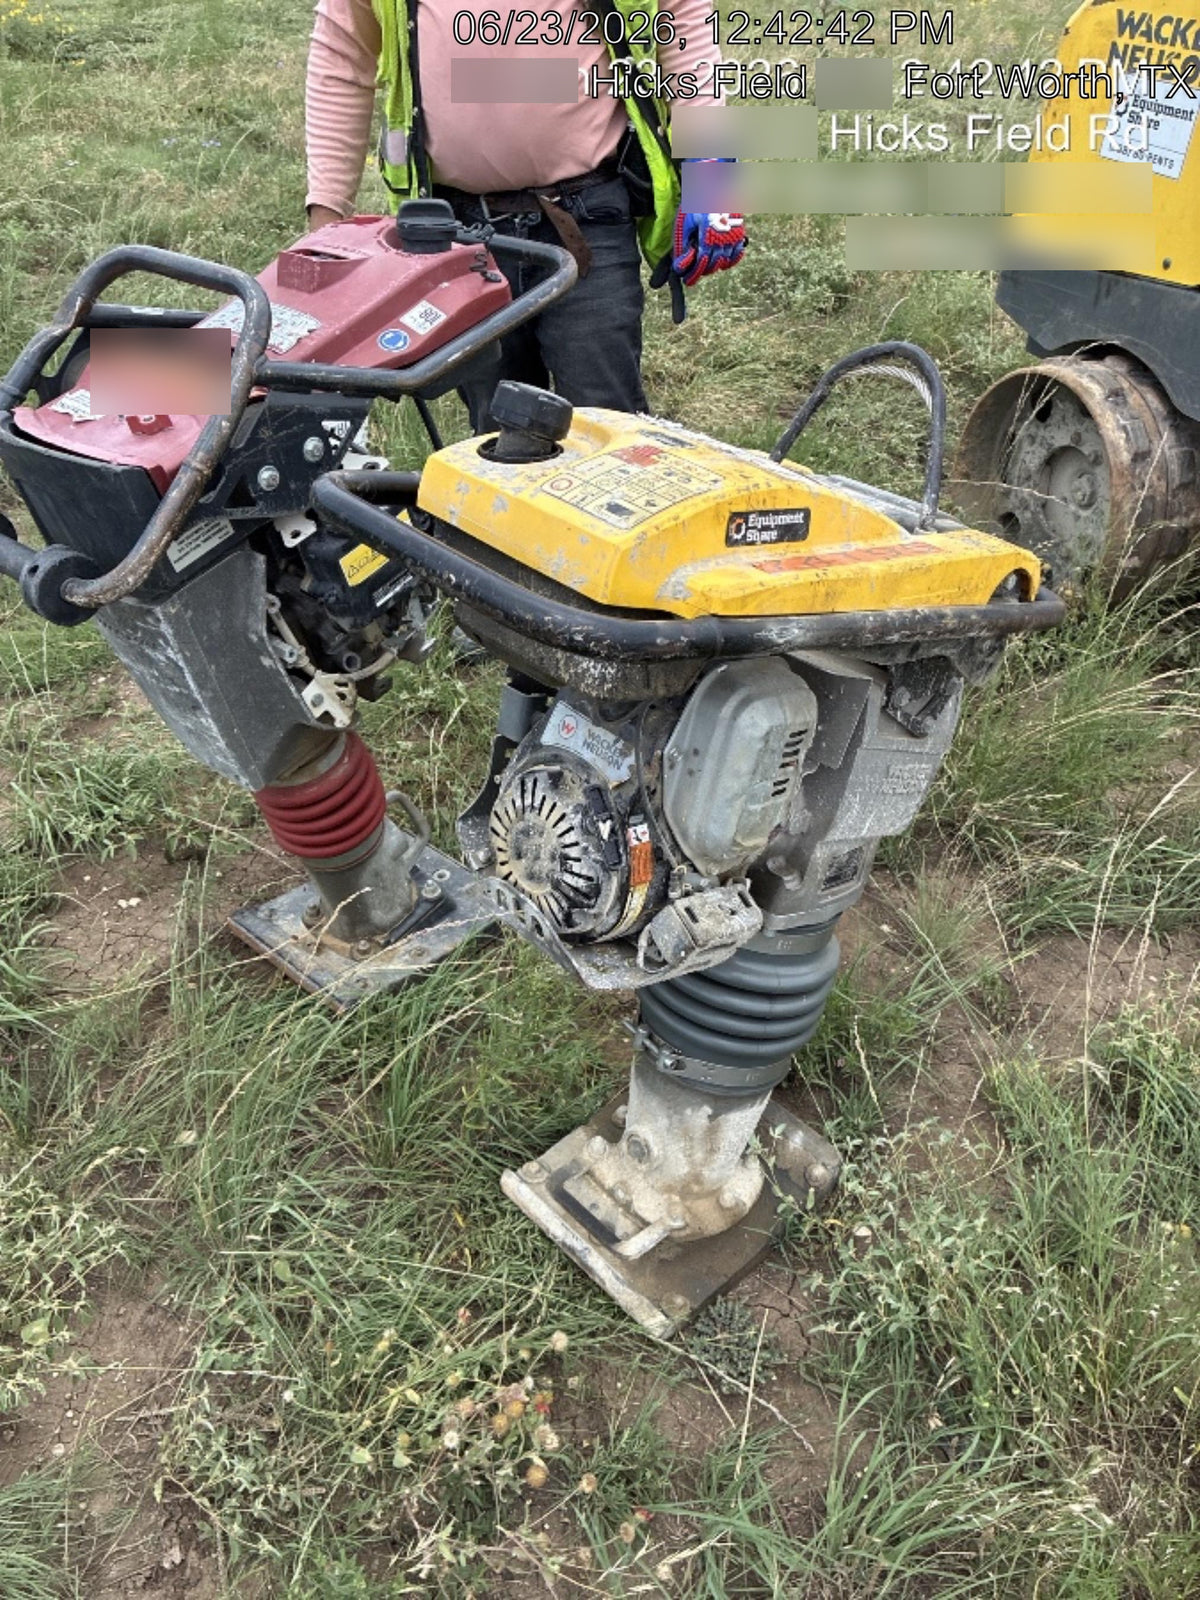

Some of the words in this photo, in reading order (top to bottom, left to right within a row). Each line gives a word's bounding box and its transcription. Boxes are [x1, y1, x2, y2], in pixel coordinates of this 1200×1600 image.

[1131, 94, 1195, 121] Equipment
[1127, 109, 1160, 130] Shre
[748, 512, 804, 528] Equipment
[746, 529, 778, 545] Share
